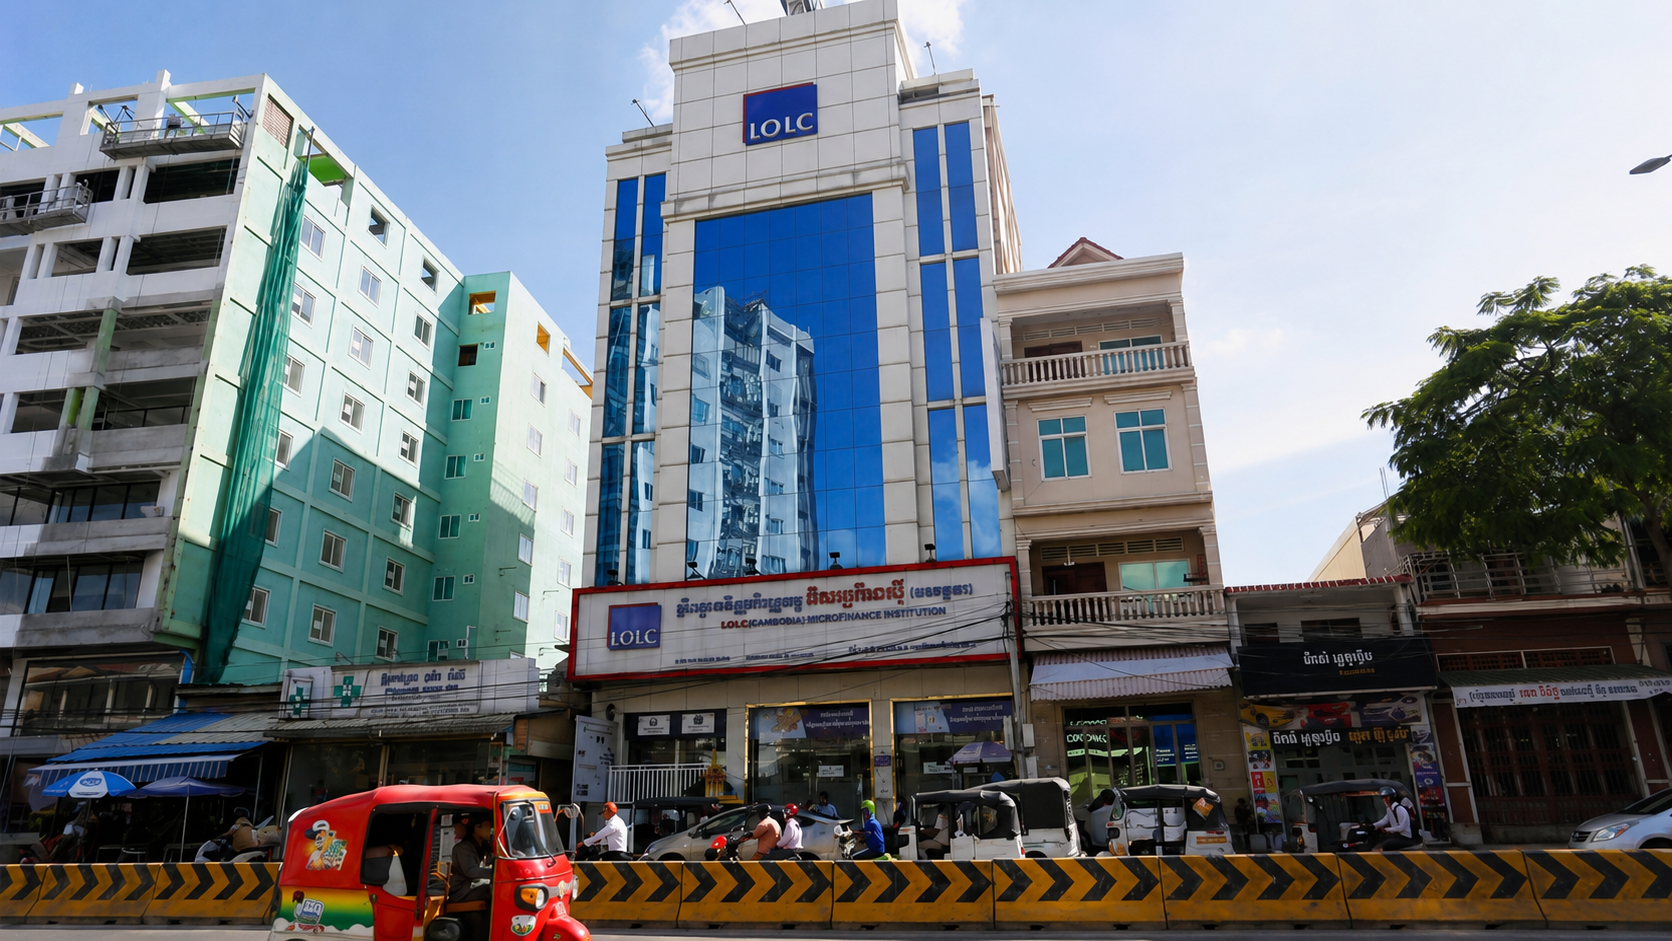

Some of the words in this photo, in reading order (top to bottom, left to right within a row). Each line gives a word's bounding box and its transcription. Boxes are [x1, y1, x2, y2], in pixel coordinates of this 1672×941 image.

[750, 112, 813, 140] LOLC
[807, 610, 882, 624] MICROFINANCE
[884, 606, 947, 619] INSTITUTION
[611, 628, 657, 646] LOLC
